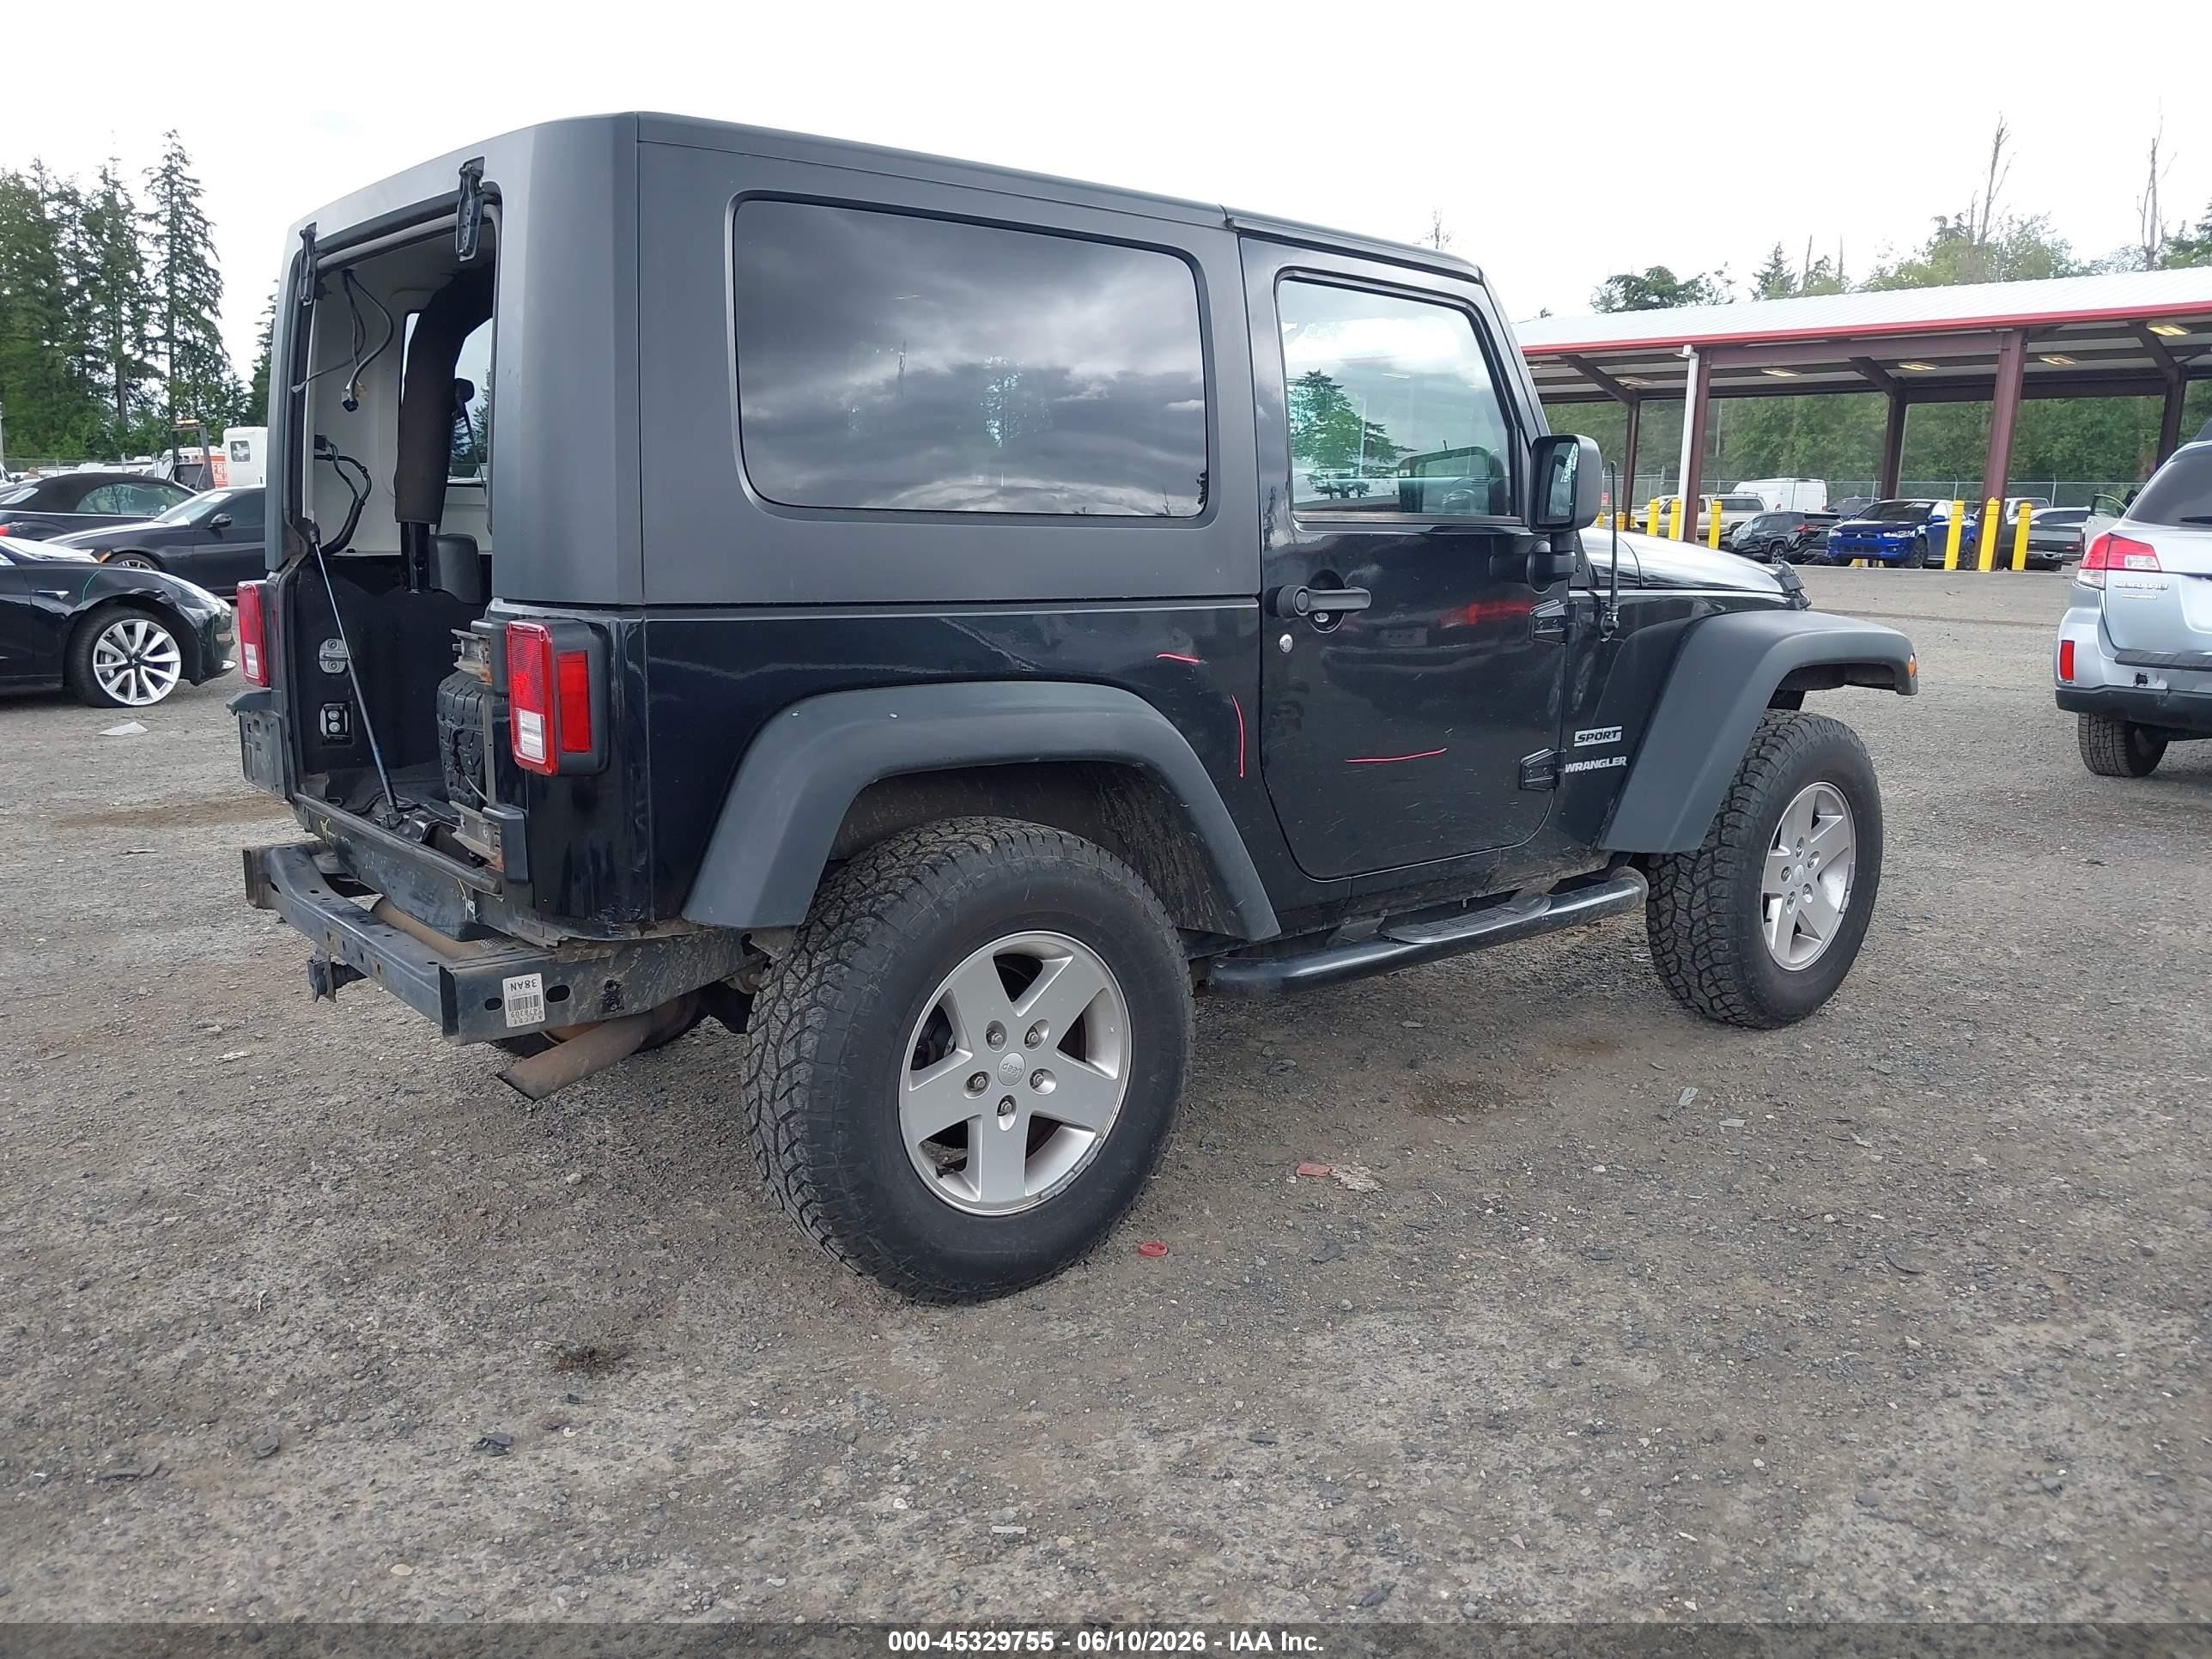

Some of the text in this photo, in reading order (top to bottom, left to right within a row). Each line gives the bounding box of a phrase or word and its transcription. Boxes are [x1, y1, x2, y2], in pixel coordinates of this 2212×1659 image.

[1575, 729, 1621, 744] SPORT
[1565, 756, 1627, 774] WRANGLER
[510, 979, 538, 992] 38AN
[1002, 1062, 1023, 1079] Jeep
